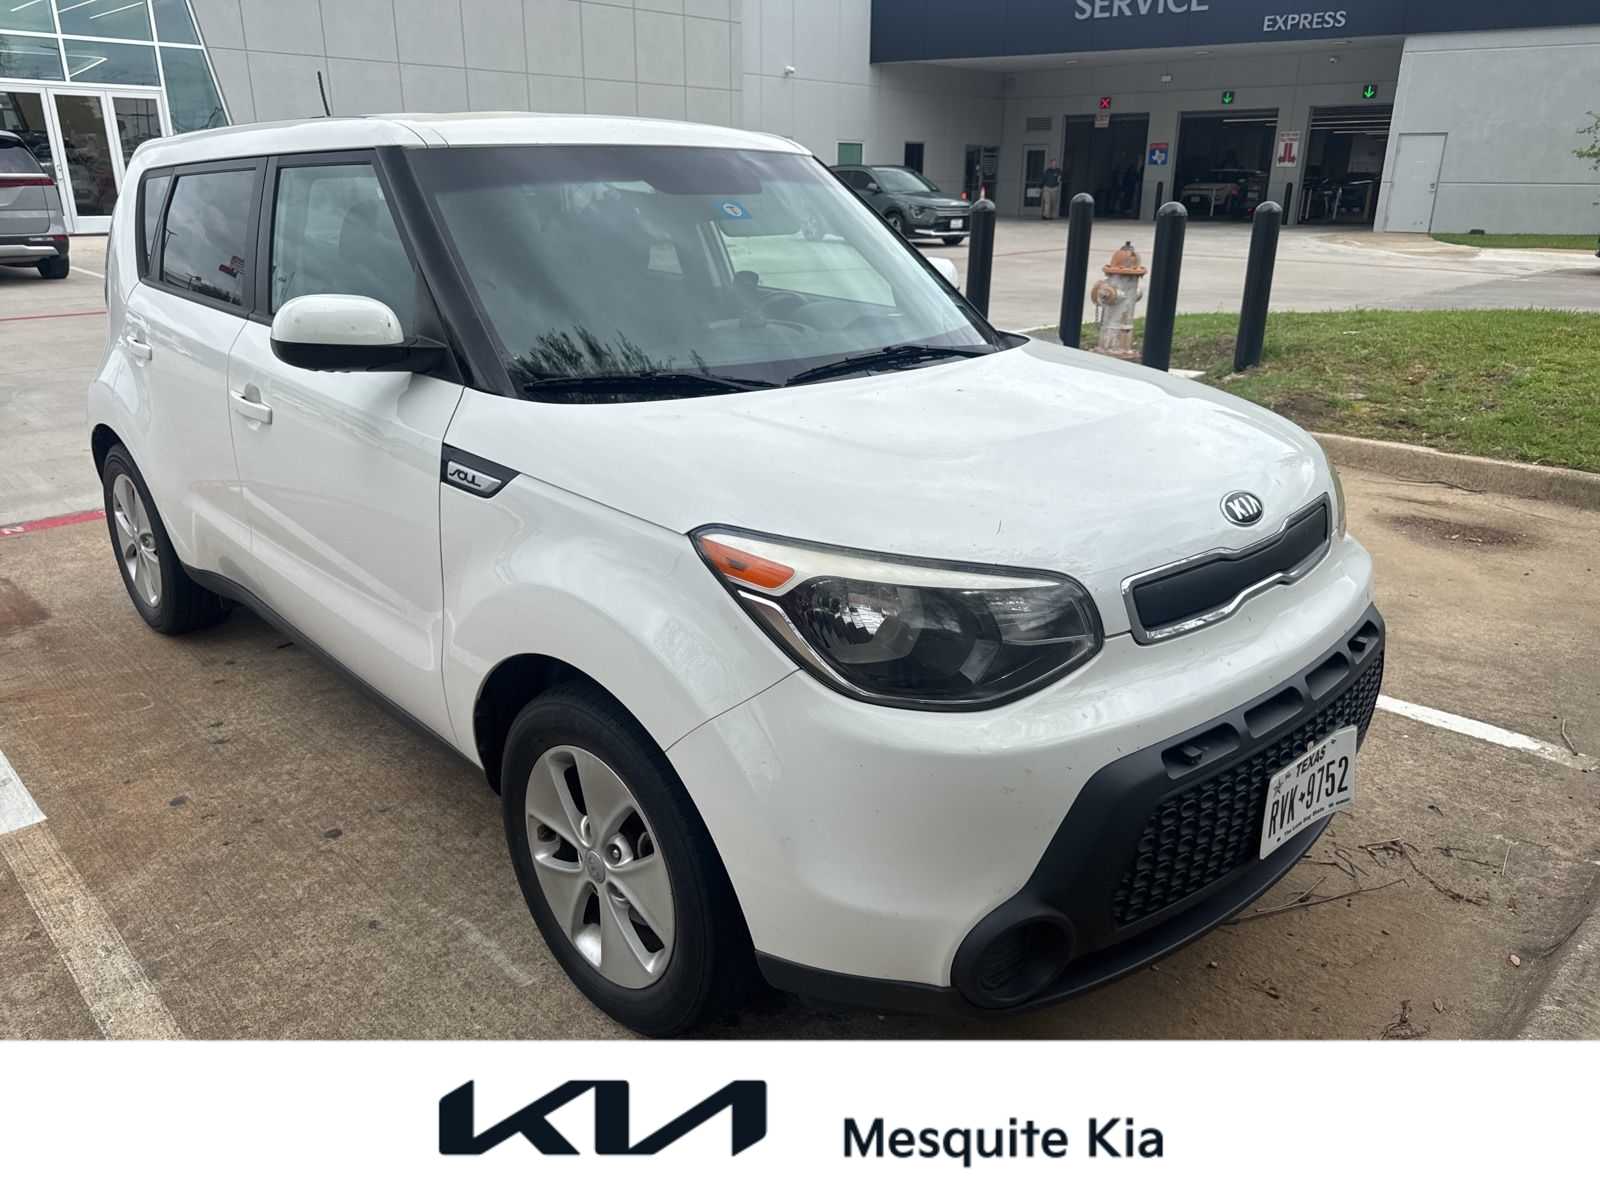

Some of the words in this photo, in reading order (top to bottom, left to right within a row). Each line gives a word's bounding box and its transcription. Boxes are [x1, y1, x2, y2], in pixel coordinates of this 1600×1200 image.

[1263, 10, 1347, 32] EXPRESS
[1226, 495, 1262, 520] KIA
[1296, 745, 1327, 777] TEXAS
